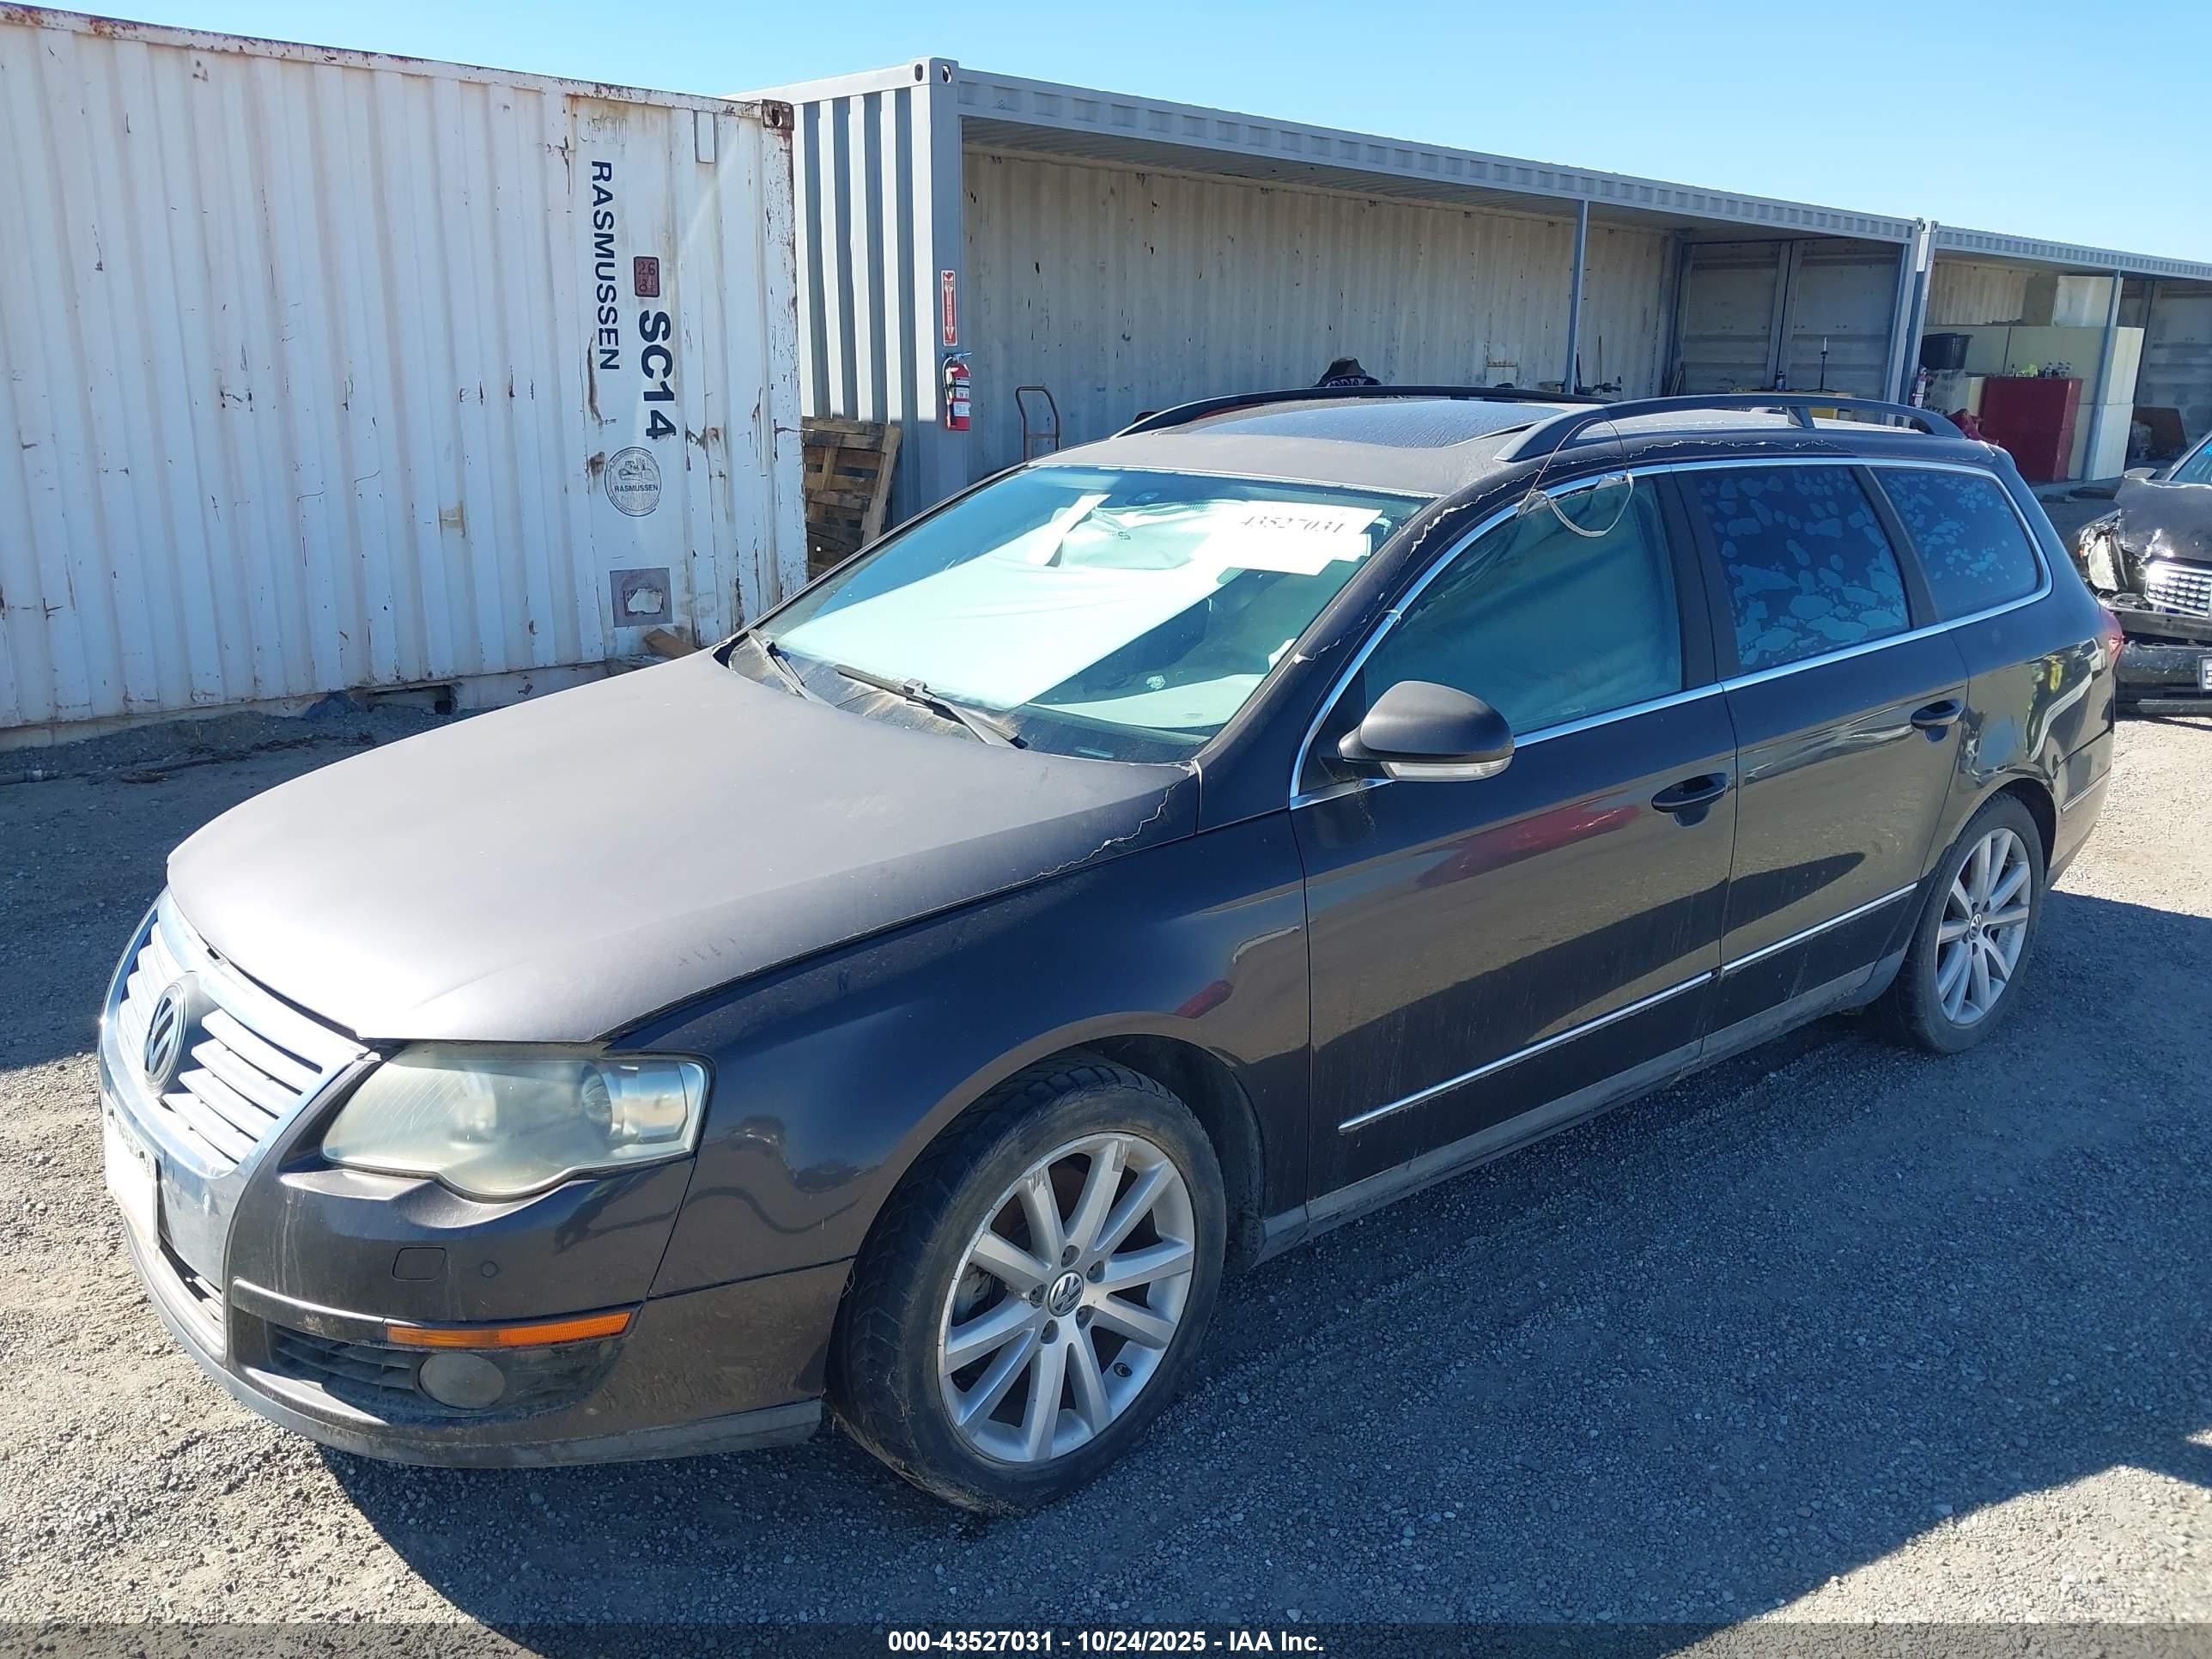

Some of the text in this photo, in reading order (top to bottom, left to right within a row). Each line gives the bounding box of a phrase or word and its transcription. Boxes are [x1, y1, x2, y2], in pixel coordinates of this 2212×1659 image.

[591, 161, 621, 371] RASMUSSEN
[639, 309, 677, 440] SC14
[614, 483, 659, 494] RASMUSSEN
